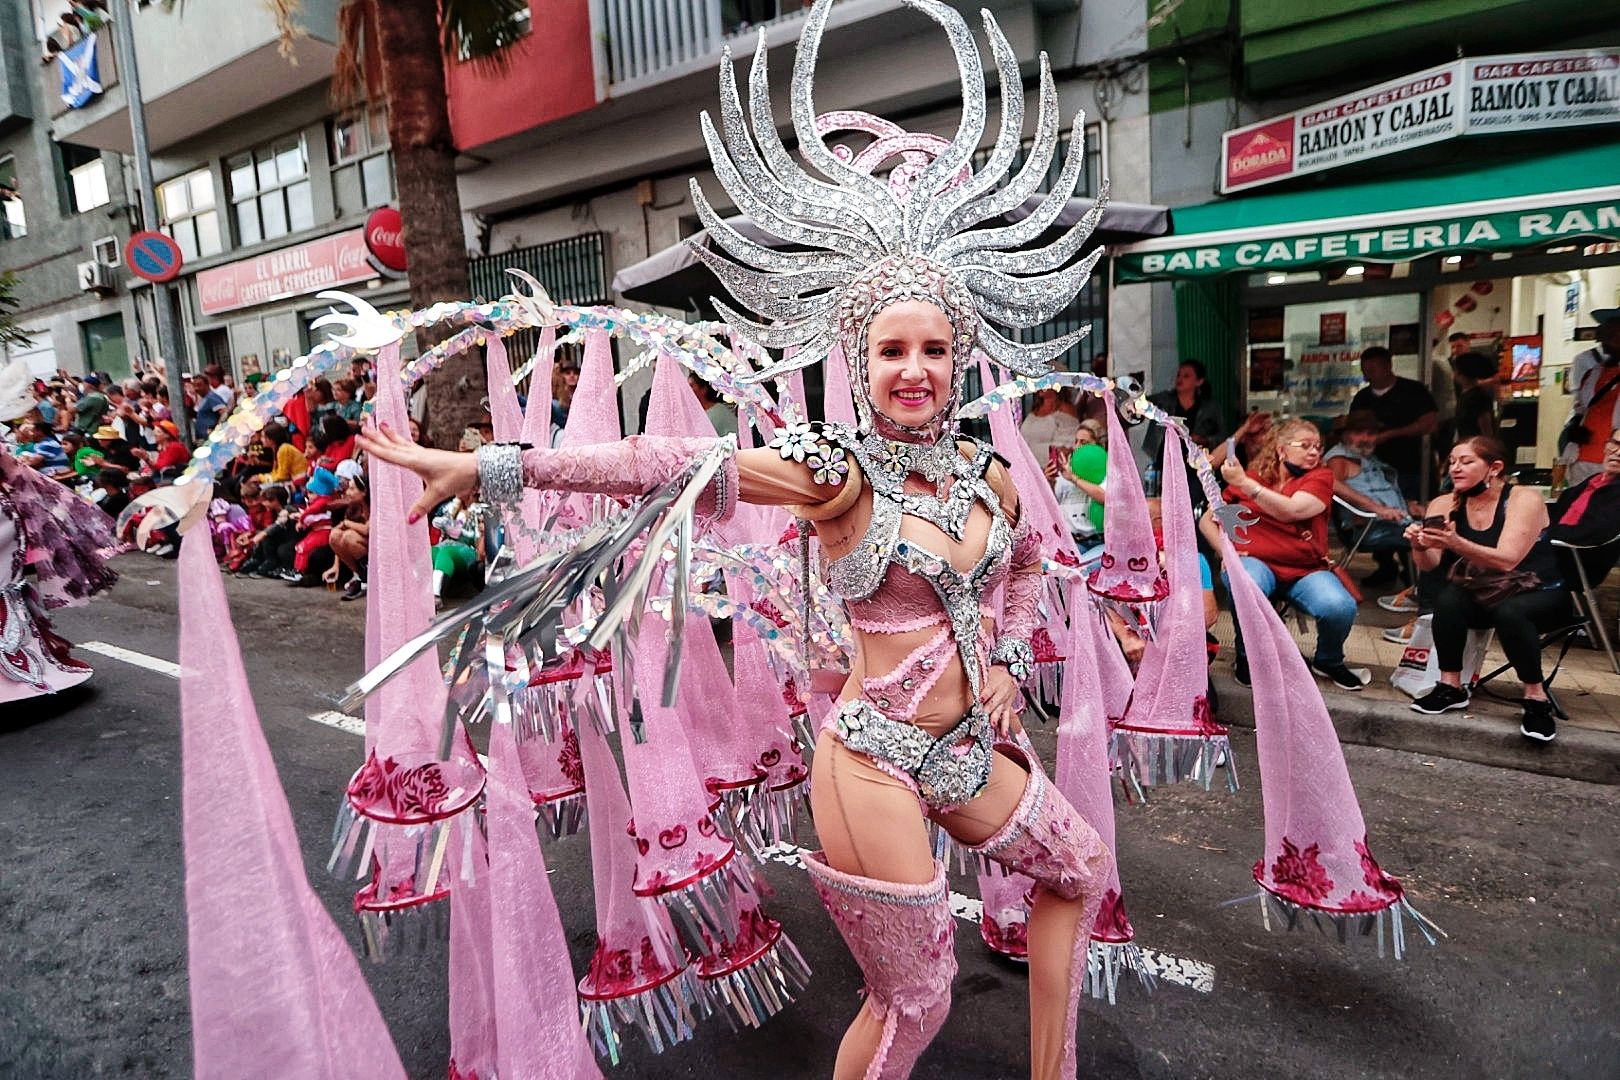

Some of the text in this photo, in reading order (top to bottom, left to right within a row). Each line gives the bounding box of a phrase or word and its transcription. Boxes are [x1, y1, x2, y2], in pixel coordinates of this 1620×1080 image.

[1478, 65, 1513, 79] BAR
[1471, 80, 1542, 113] RAMÓN
[1546, 80, 1560, 106] Y
[1300, 92, 1454, 156] RAMÓN Y CAJAL
[1232, 147, 1287, 172] DORADA
[1142, 248, 1221, 273] BAR
[1235, 219, 1500, 266] CAFETERIA
[256, 249, 312, 280] EL BARRIL
